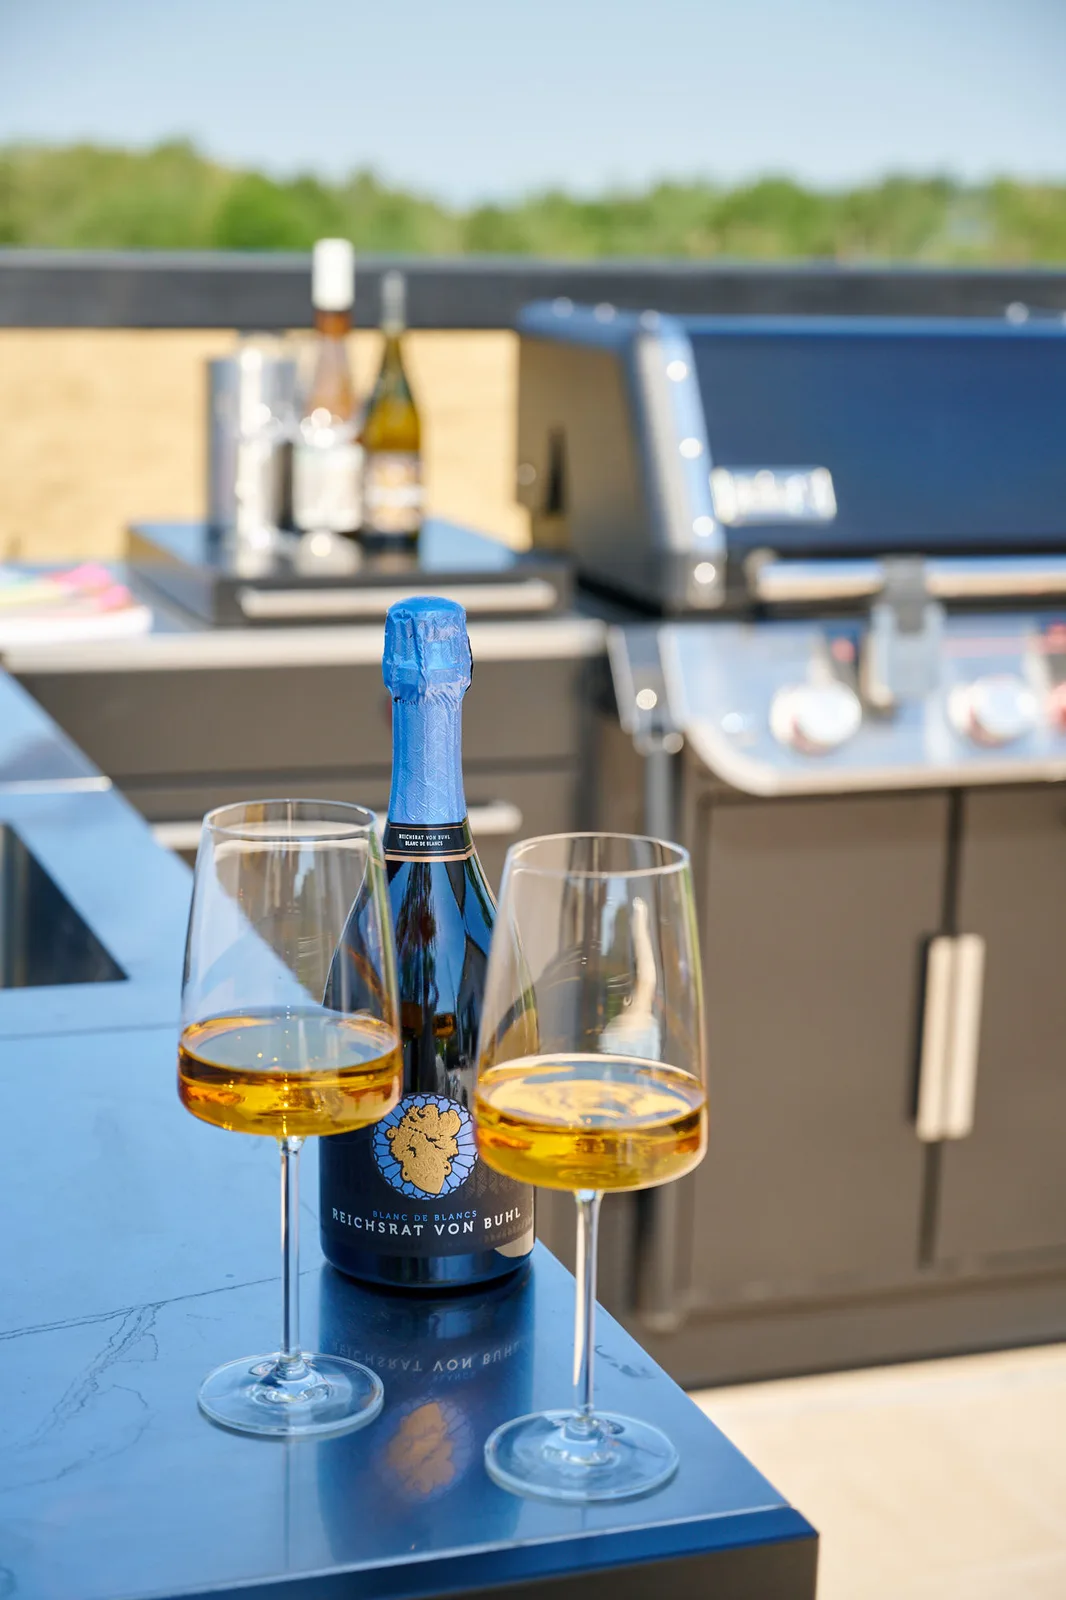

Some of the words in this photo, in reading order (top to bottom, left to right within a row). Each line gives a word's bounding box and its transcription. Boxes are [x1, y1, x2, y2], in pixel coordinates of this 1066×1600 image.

[332, 1207, 424, 1236] REICHSRAT
[434, 1220, 474, 1236] VON
[483, 1207, 521, 1229] BUHL
[373, 1210, 408, 1221] BLANC
[414, 1214, 428, 1222] DE
[434, 1210, 477, 1222] BLANCS
